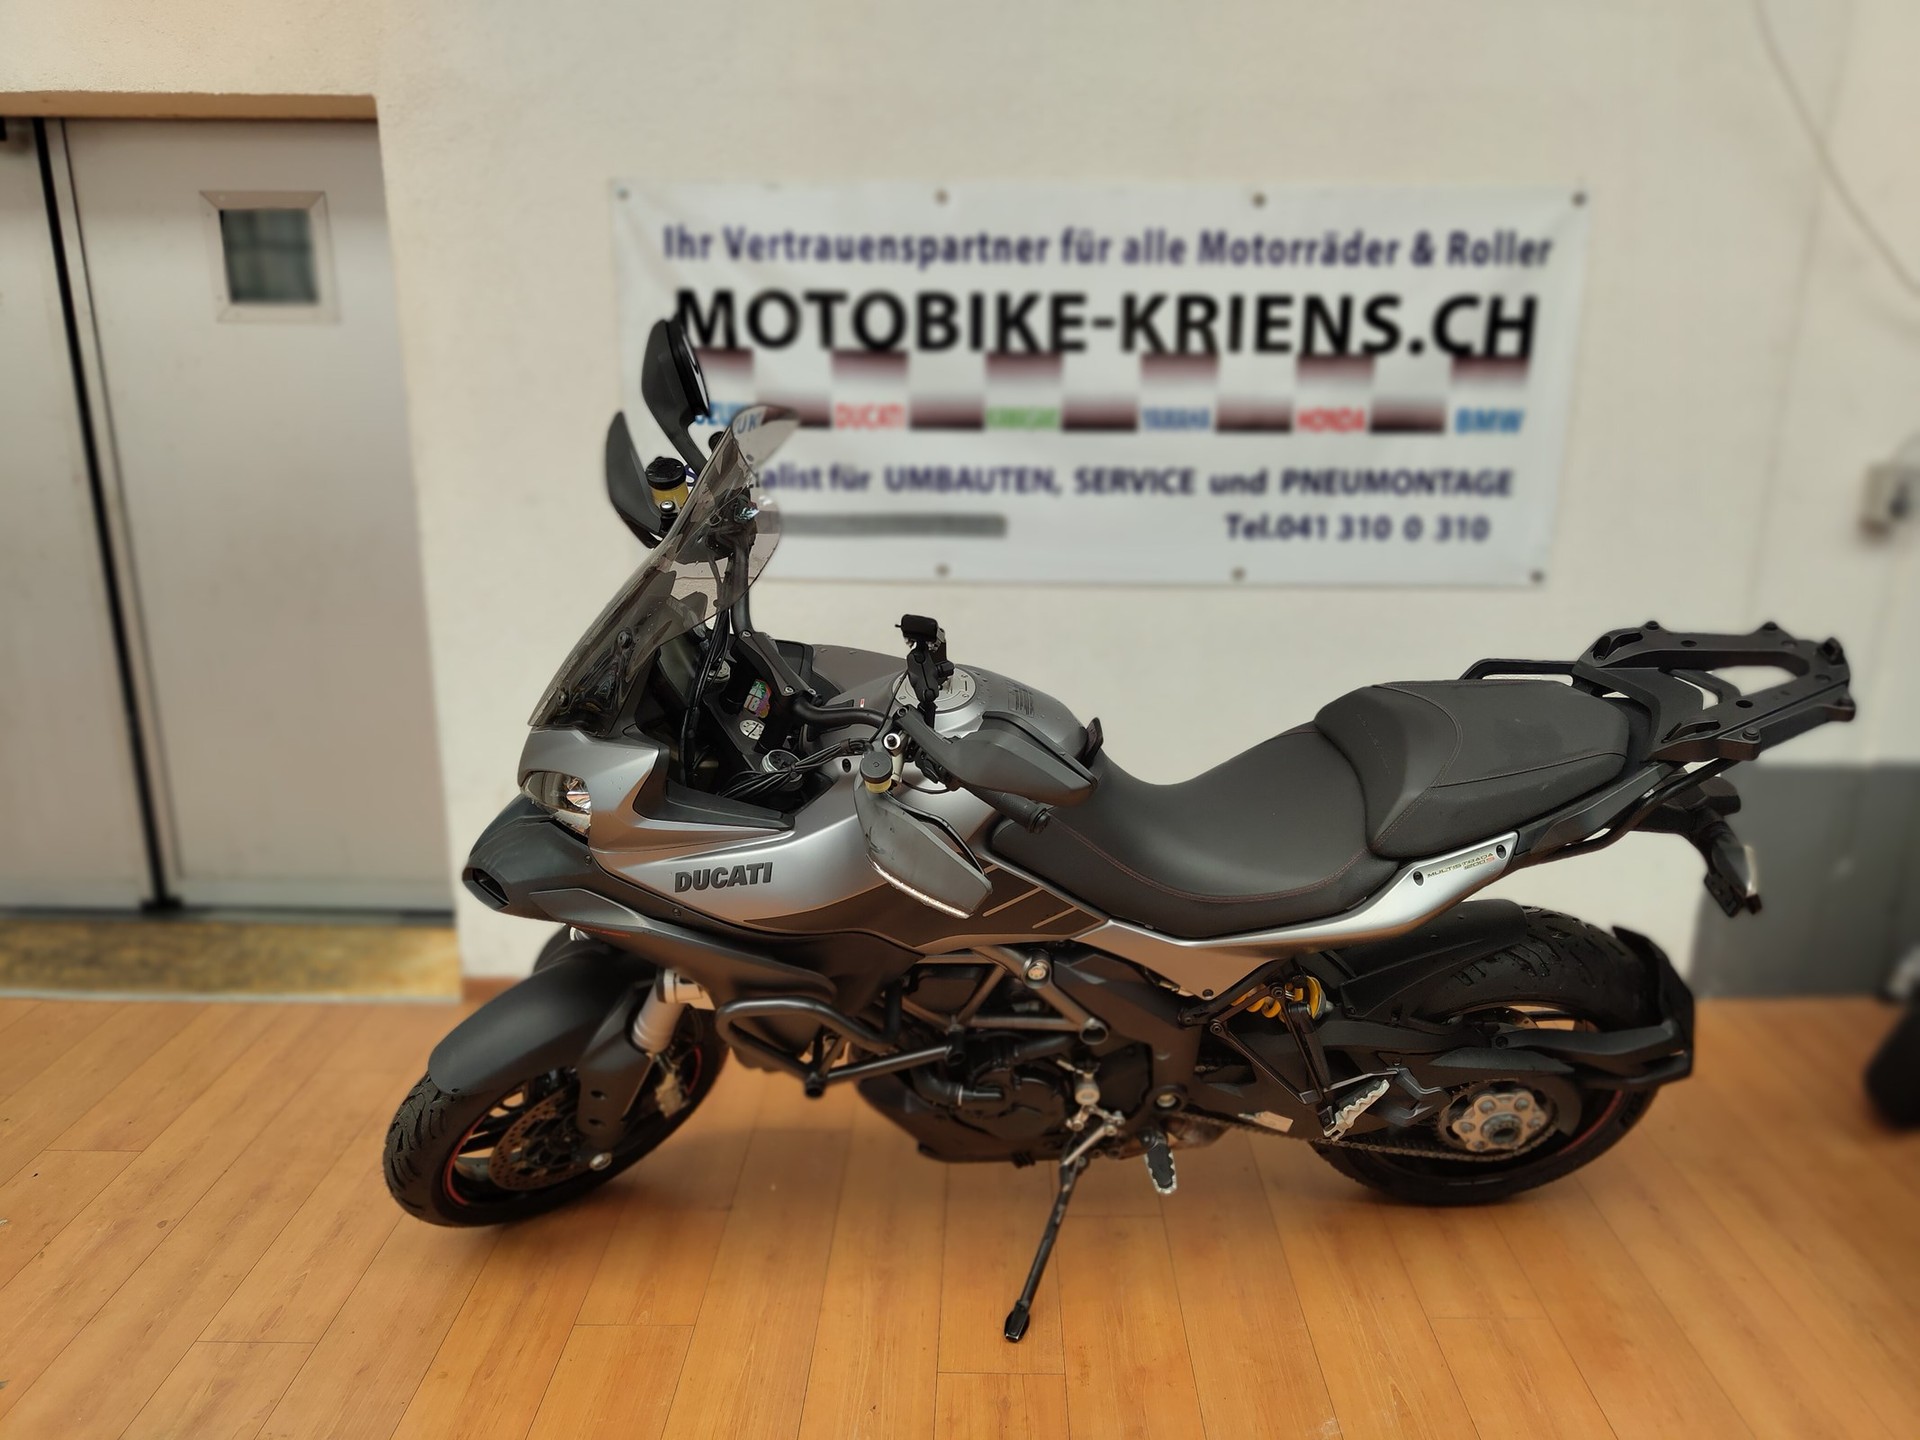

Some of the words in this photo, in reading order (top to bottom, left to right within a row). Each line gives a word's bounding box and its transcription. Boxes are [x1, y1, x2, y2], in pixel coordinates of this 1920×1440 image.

[664, 226, 712, 260] Ihr
[723, 227, 1049, 269] Vertrauenspartner
[1060, 229, 1111, 264] für
[1122, 230, 1187, 266] alle
[1198, 231, 1400, 267] Motorräder
[1410, 233, 1436, 267] &
[1447, 231, 1554, 267] Roller
[675, 290, 1538, 357] MOTOBIKE-KRIENS.CH
[1296, 405, 1367, 433] HONDA
[1454, 406, 1525, 435] BMW
[829, 462, 872, 490] für
[884, 465, 1064, 496] UMBAUTEN,
[1073, 467, 1197, 496] SERVICE
[1210, 468, 1268, 496] und
[1280, 469, 1515, 497] PNEUMONTAGE
[1337, 514, 1393, 542] 310
[1403, 515, 1424, 542] 0
[1433, 514, 1492, 543] 310
[674, 862, 774, 893] DUCATI
